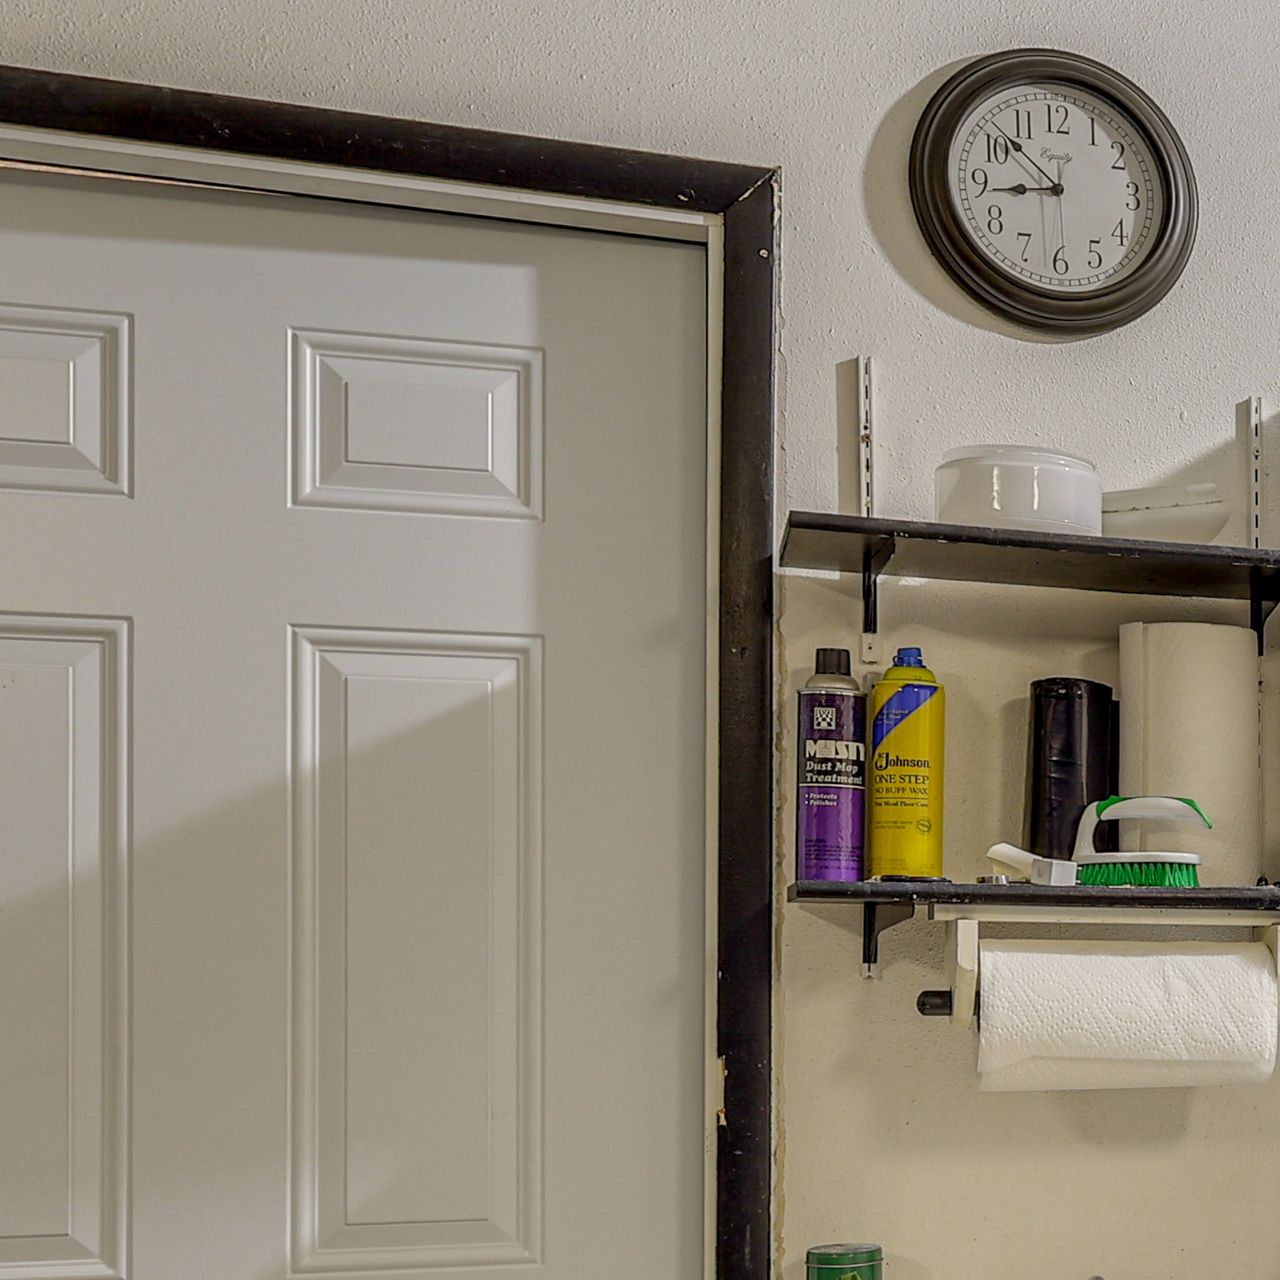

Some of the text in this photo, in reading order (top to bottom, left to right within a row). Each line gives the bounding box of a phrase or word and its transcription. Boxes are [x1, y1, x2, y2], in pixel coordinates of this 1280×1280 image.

[1013, 109, 1034, 140] 11
[1044, 104, 1070, 134] 12
[1088, 118, 1098, 146] 1
[984, 134, 1008, 165] 10
[1040, 147, 1073, 163] Equity
[1111, 142, 1126, 170] 2
[971, 169, 988, 198] 9
[1126, 182, 1140, 211] 3
[988, 205, 1003, 235] 8
[1112, 218, 1128, 246] 4
[1017, 233, 1032, 262] 7
[1053, 246, 1068, 274] 6
[1088, 240, 1101, 269] 5
[805, 740, 865, 761] MISTY
[875, 752, 929, 771] Johnson
[806, 761, 858, 773] Dust Mop
[806, 773, 862, 784] Treatment
[875, 775, 929, 784] ONE STEP
